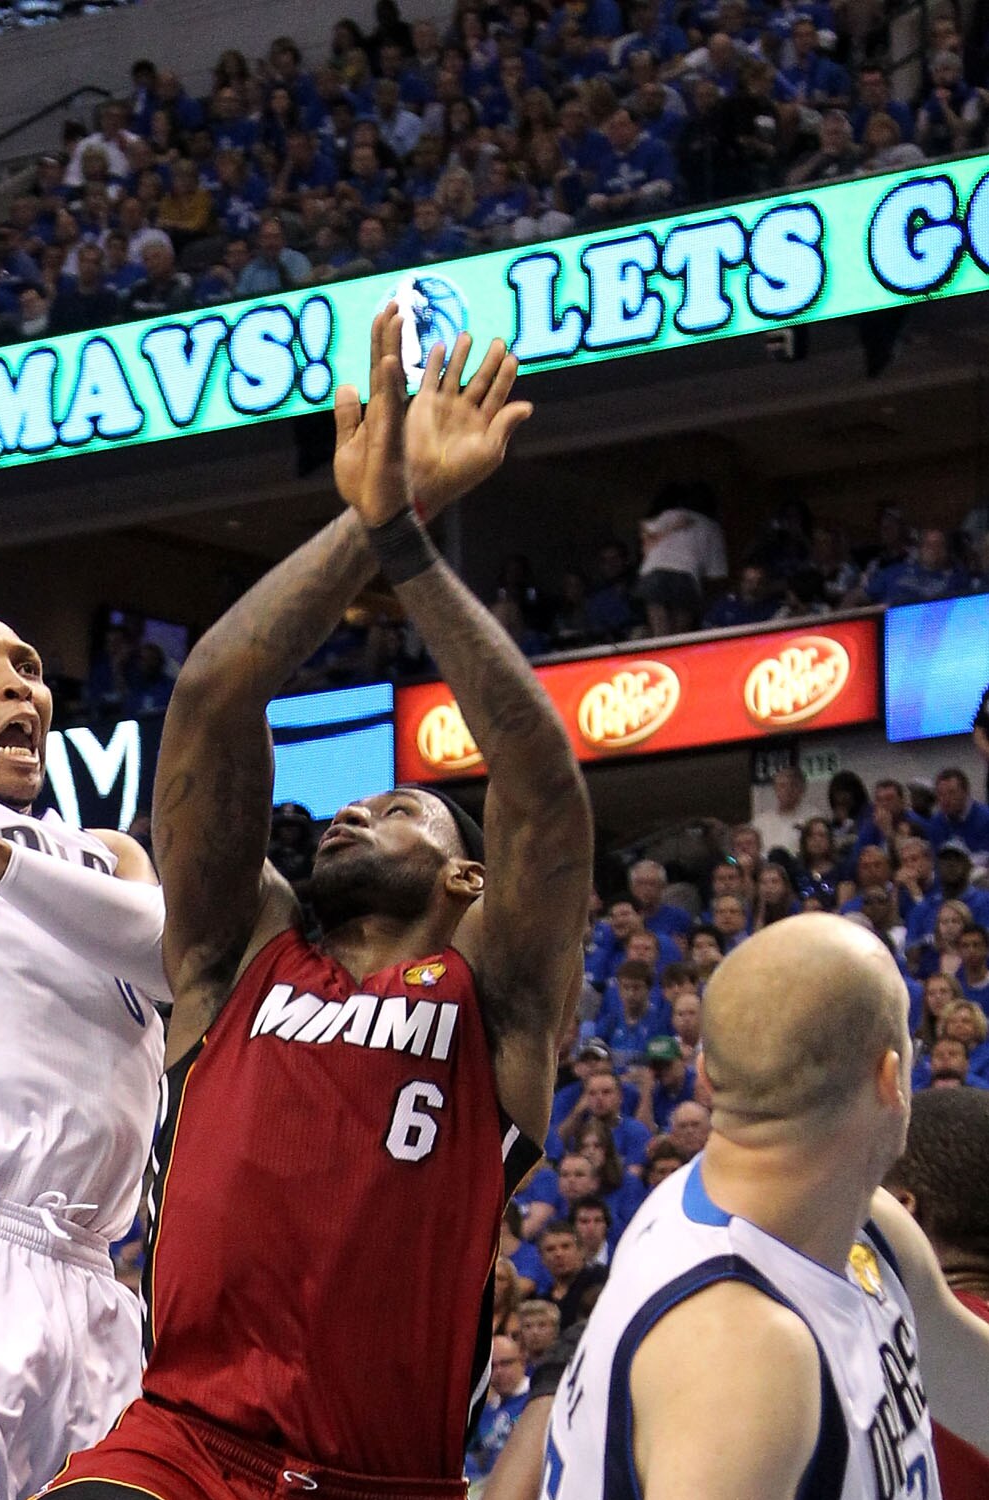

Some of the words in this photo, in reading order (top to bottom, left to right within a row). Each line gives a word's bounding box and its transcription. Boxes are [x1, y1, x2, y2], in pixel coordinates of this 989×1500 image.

[508, 202, 825, 362] LETS
[868, 173, 989, 297] G
[249, 983, 459, 1061] MIAMI
[386, 1080, 444, 1162] 6
